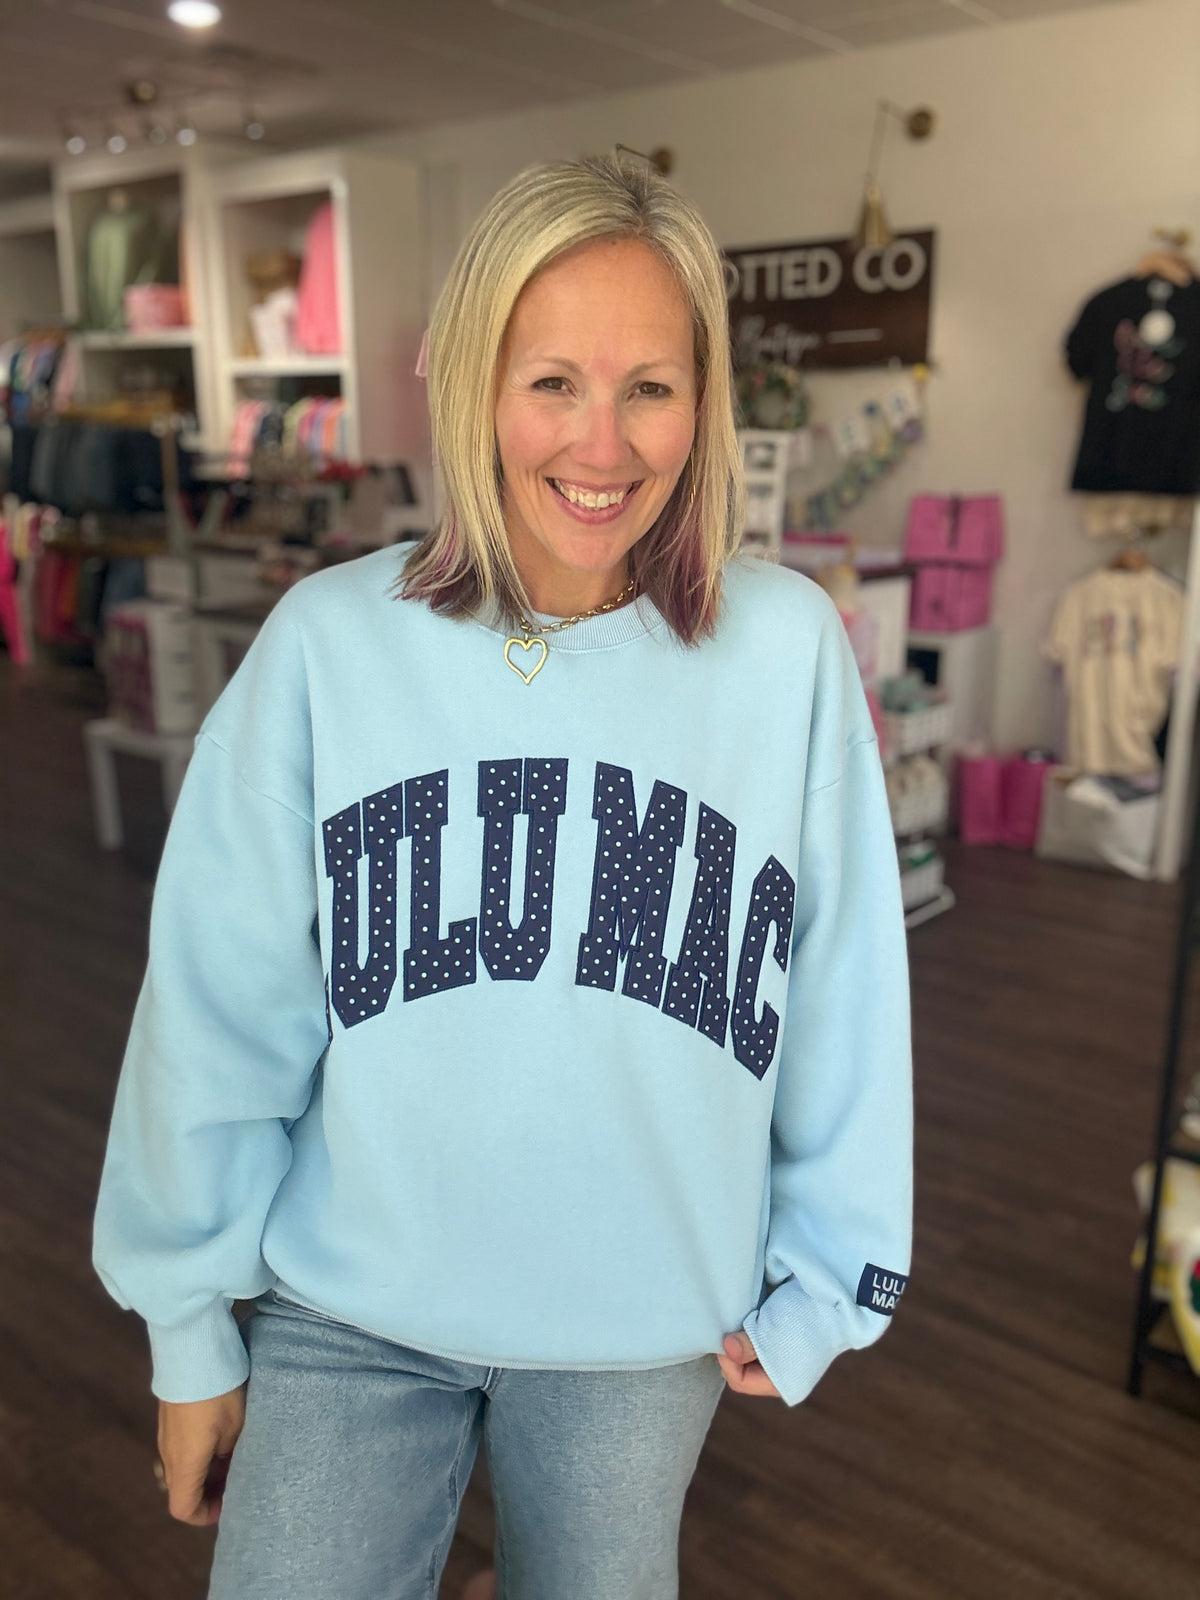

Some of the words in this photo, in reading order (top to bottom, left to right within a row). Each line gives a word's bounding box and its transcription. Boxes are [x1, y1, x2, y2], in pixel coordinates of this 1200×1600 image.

[853, 238, 927, 293] CO
[322, 757, 569, 1045] ULU
[575, 760, 796, 1081] MAC
[871, 1290, 900, 1310] MA
